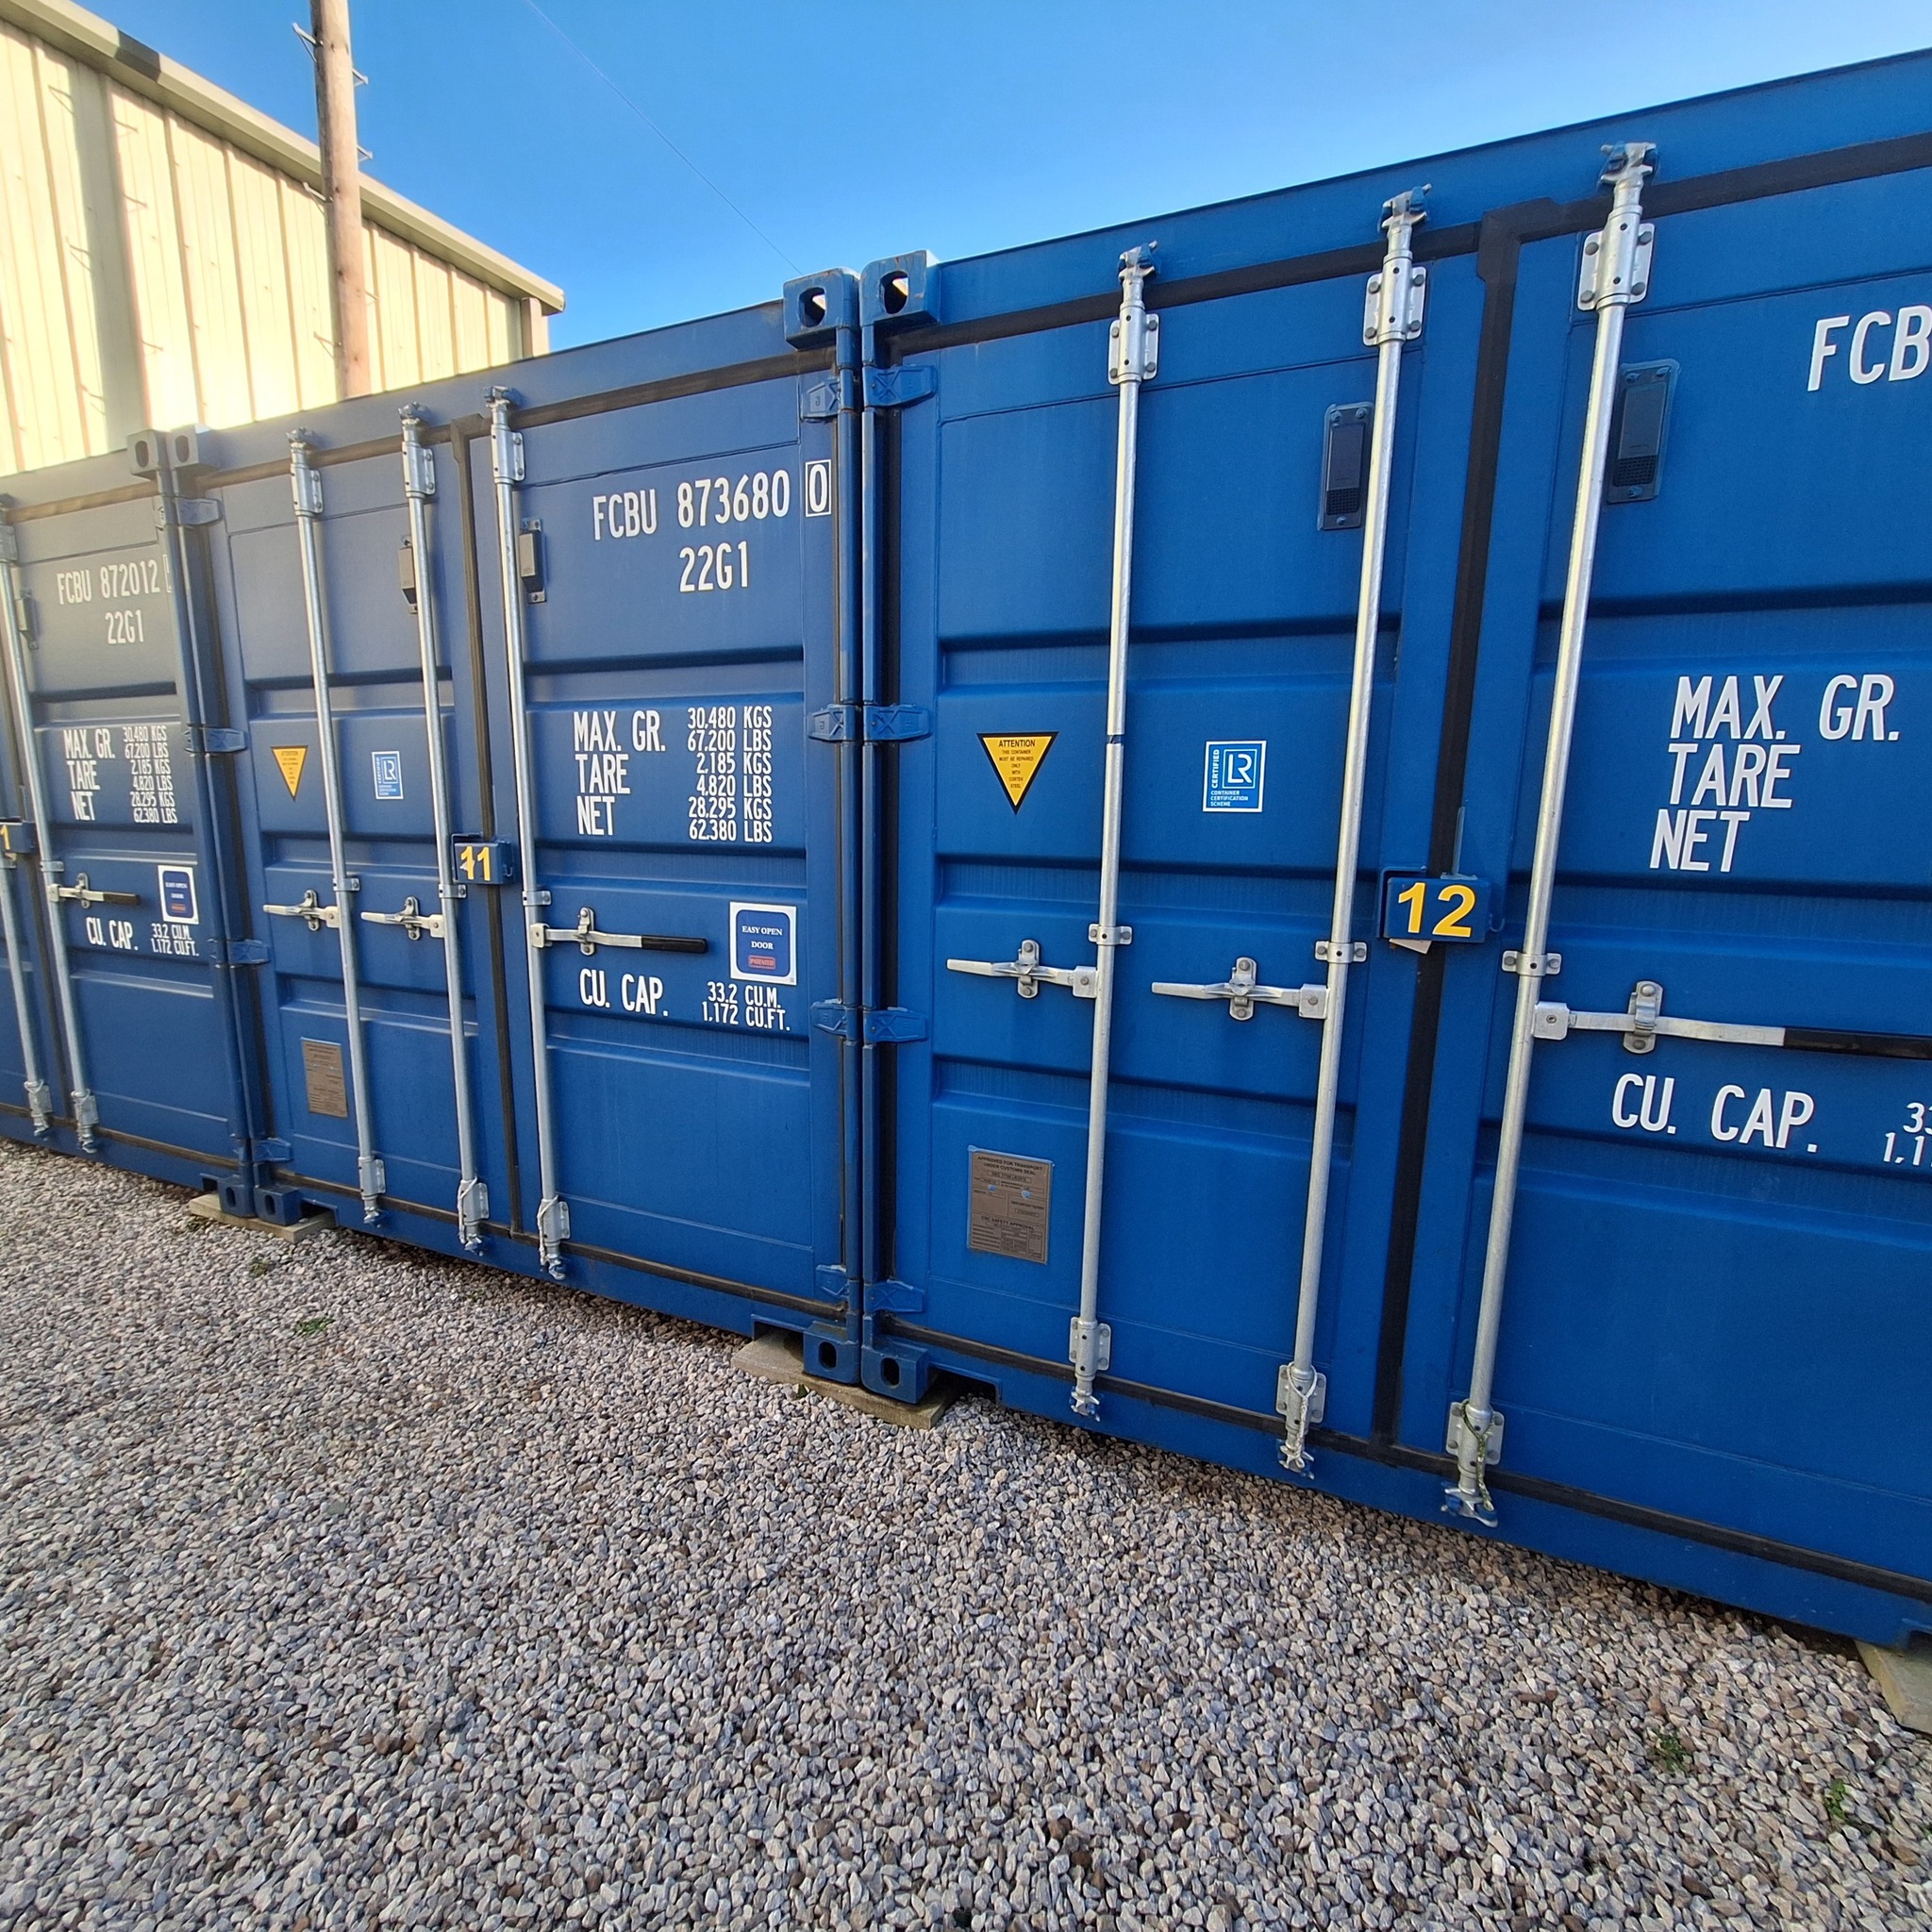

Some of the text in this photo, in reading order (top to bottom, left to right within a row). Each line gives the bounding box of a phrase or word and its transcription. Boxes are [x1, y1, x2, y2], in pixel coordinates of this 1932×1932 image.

[1807, 305, 1932, 391] FCB
[592, 464, 827, 541] FCBU 873680 0
[679, 541, 748, 592] 22G1
[57, 570, 92, 605] FCBU
[100, 559, 160, 598] 872012
[105, 609, 143, 644] 22G1
[687, 706, 773, 729] 30,480 KGS
[1670, 674, 1900, 741] MAX. GR.
[63, 728, 115, 758] MAX. GR.
[151, 725, 167, 741] KGS
[574, 709, 666, 752] MAX. GR.
[687, 729, 773, 752] 67,200 LBS
[152, 742, 169, 758] LBS
[696, 752, 773, 774] 2,185 KGS
[67, 760, 100, 790] TARE
[154, 759, 171, 774] KGS
[575, 753, 631, 794] TARE
[1227, 754, 1253, 783] LR
[1668, 743, 1801, 808] TARE
[156, 775, 174, 791] LBS
[696, 774, 773, 797] 4,820 LBS
[71, 791, 95, 821] NET
[158, 791, 175, 807] KGS
[688, 796, 773, 820] 28,295 KGS
[160, 808, 178, 824] LBS
[576, 795, 615, 836] NET
[689, 819, 773, 842] 62,380 LBS
[1650, 808, 1751, 873] NET
[460, 845, 491, 882] 11
[1398, 882, 1475, 938] 12
[86, 917, 139, 951] CU. CAP.
[741, 925, 783, 936] EASY OPEN
[751, 941, 774, 950] DOOR
[579, 968, 669, 1017] CU. CAP.
[708, 981, 782, 1008] 33.2 CU.M.
[702, 1001, 791, 1031] 1,172 CU.FT.
[1611, 1073, 1818, 1153] CU. CAP.
[1883, 1132, 1932, 1168] 1,1
